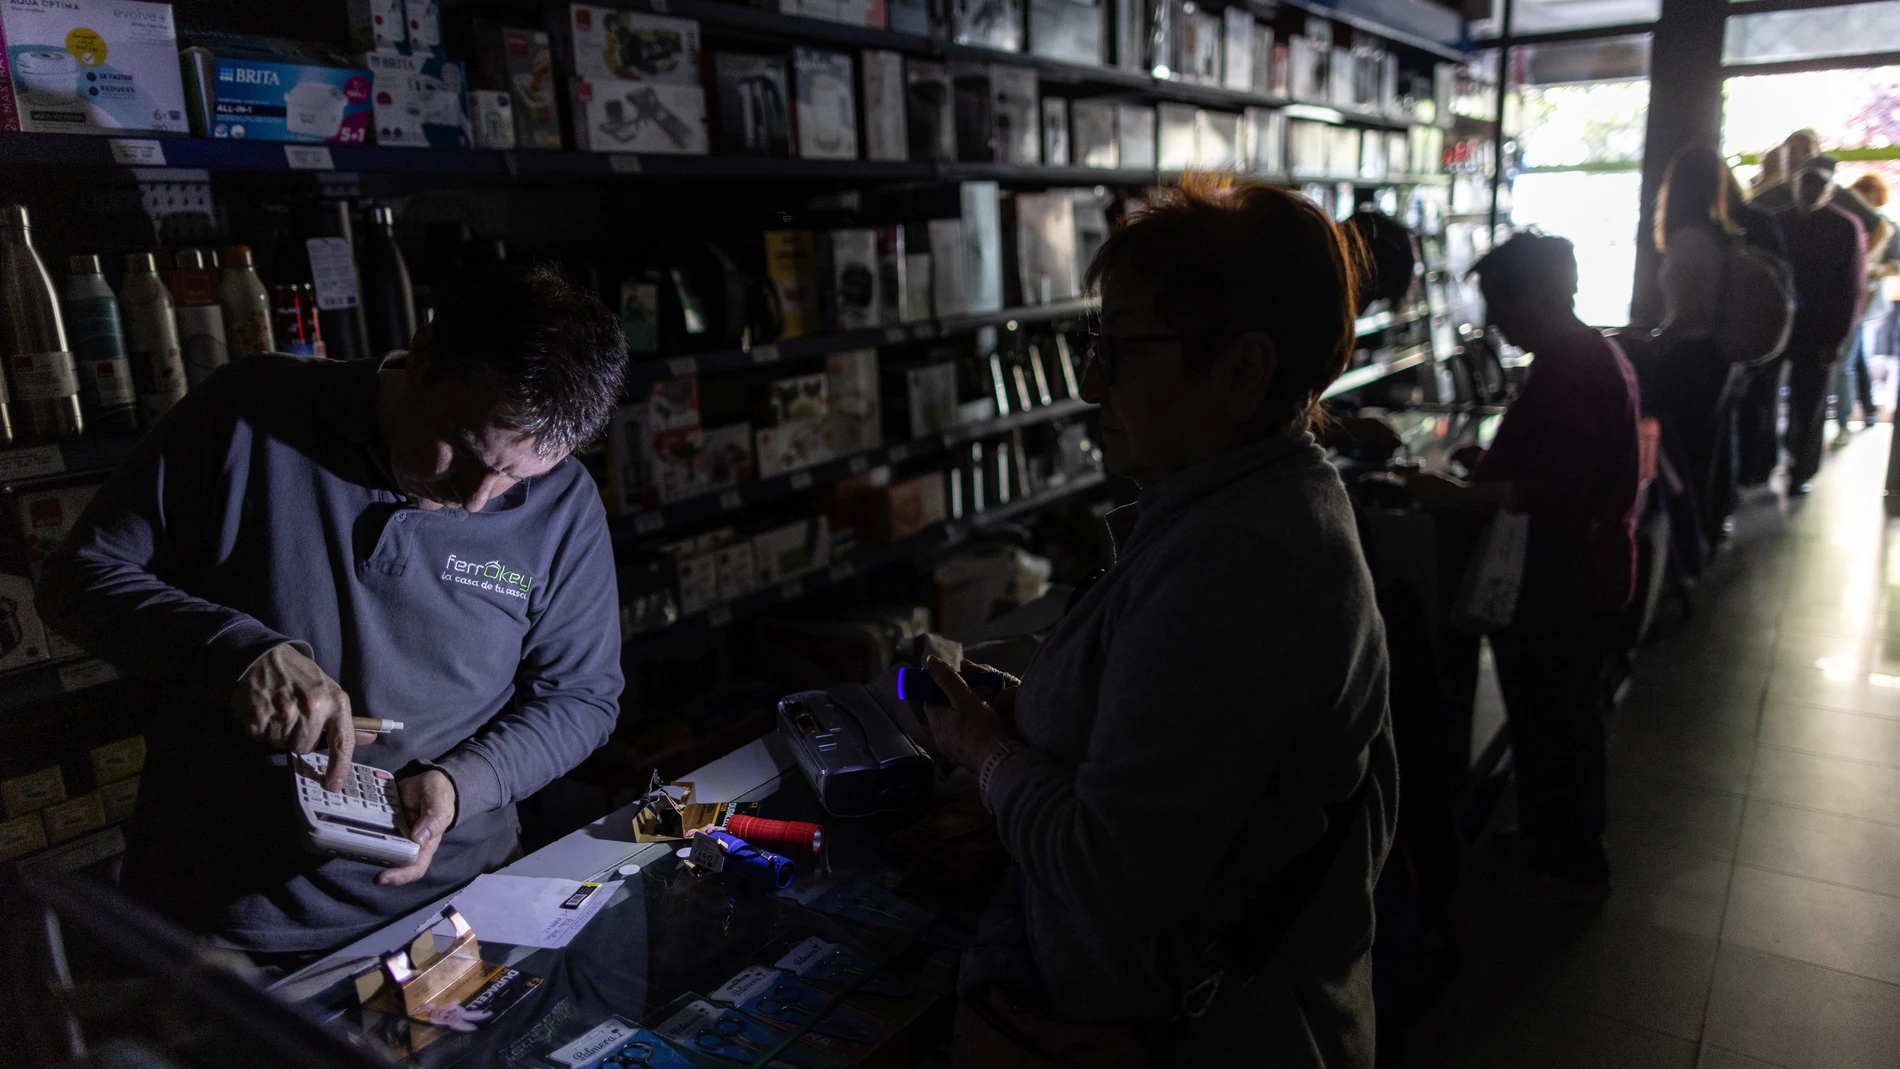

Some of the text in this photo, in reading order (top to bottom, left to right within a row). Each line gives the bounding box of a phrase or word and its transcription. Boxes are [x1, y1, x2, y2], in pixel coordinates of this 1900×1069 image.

[42, 0, 80, 10] OPTIMA
[113, 8, 157, 22] evolve
[236, 68, 280, 86] BRITA
[100, 84, 135, 93] REDUCES
[216, 103, 252, 114] ALL-IN-1
[340, 127, 365, 142] 5+1
[442, 571, 527, 599] la casa de tu casa
[465, 969, 520, 1010] DURACELL
[730, 977, 762, 998] Palmera
[670, 1014, 704, 1036] Palmera
[572, 1036, 617, 1061] Palmera
